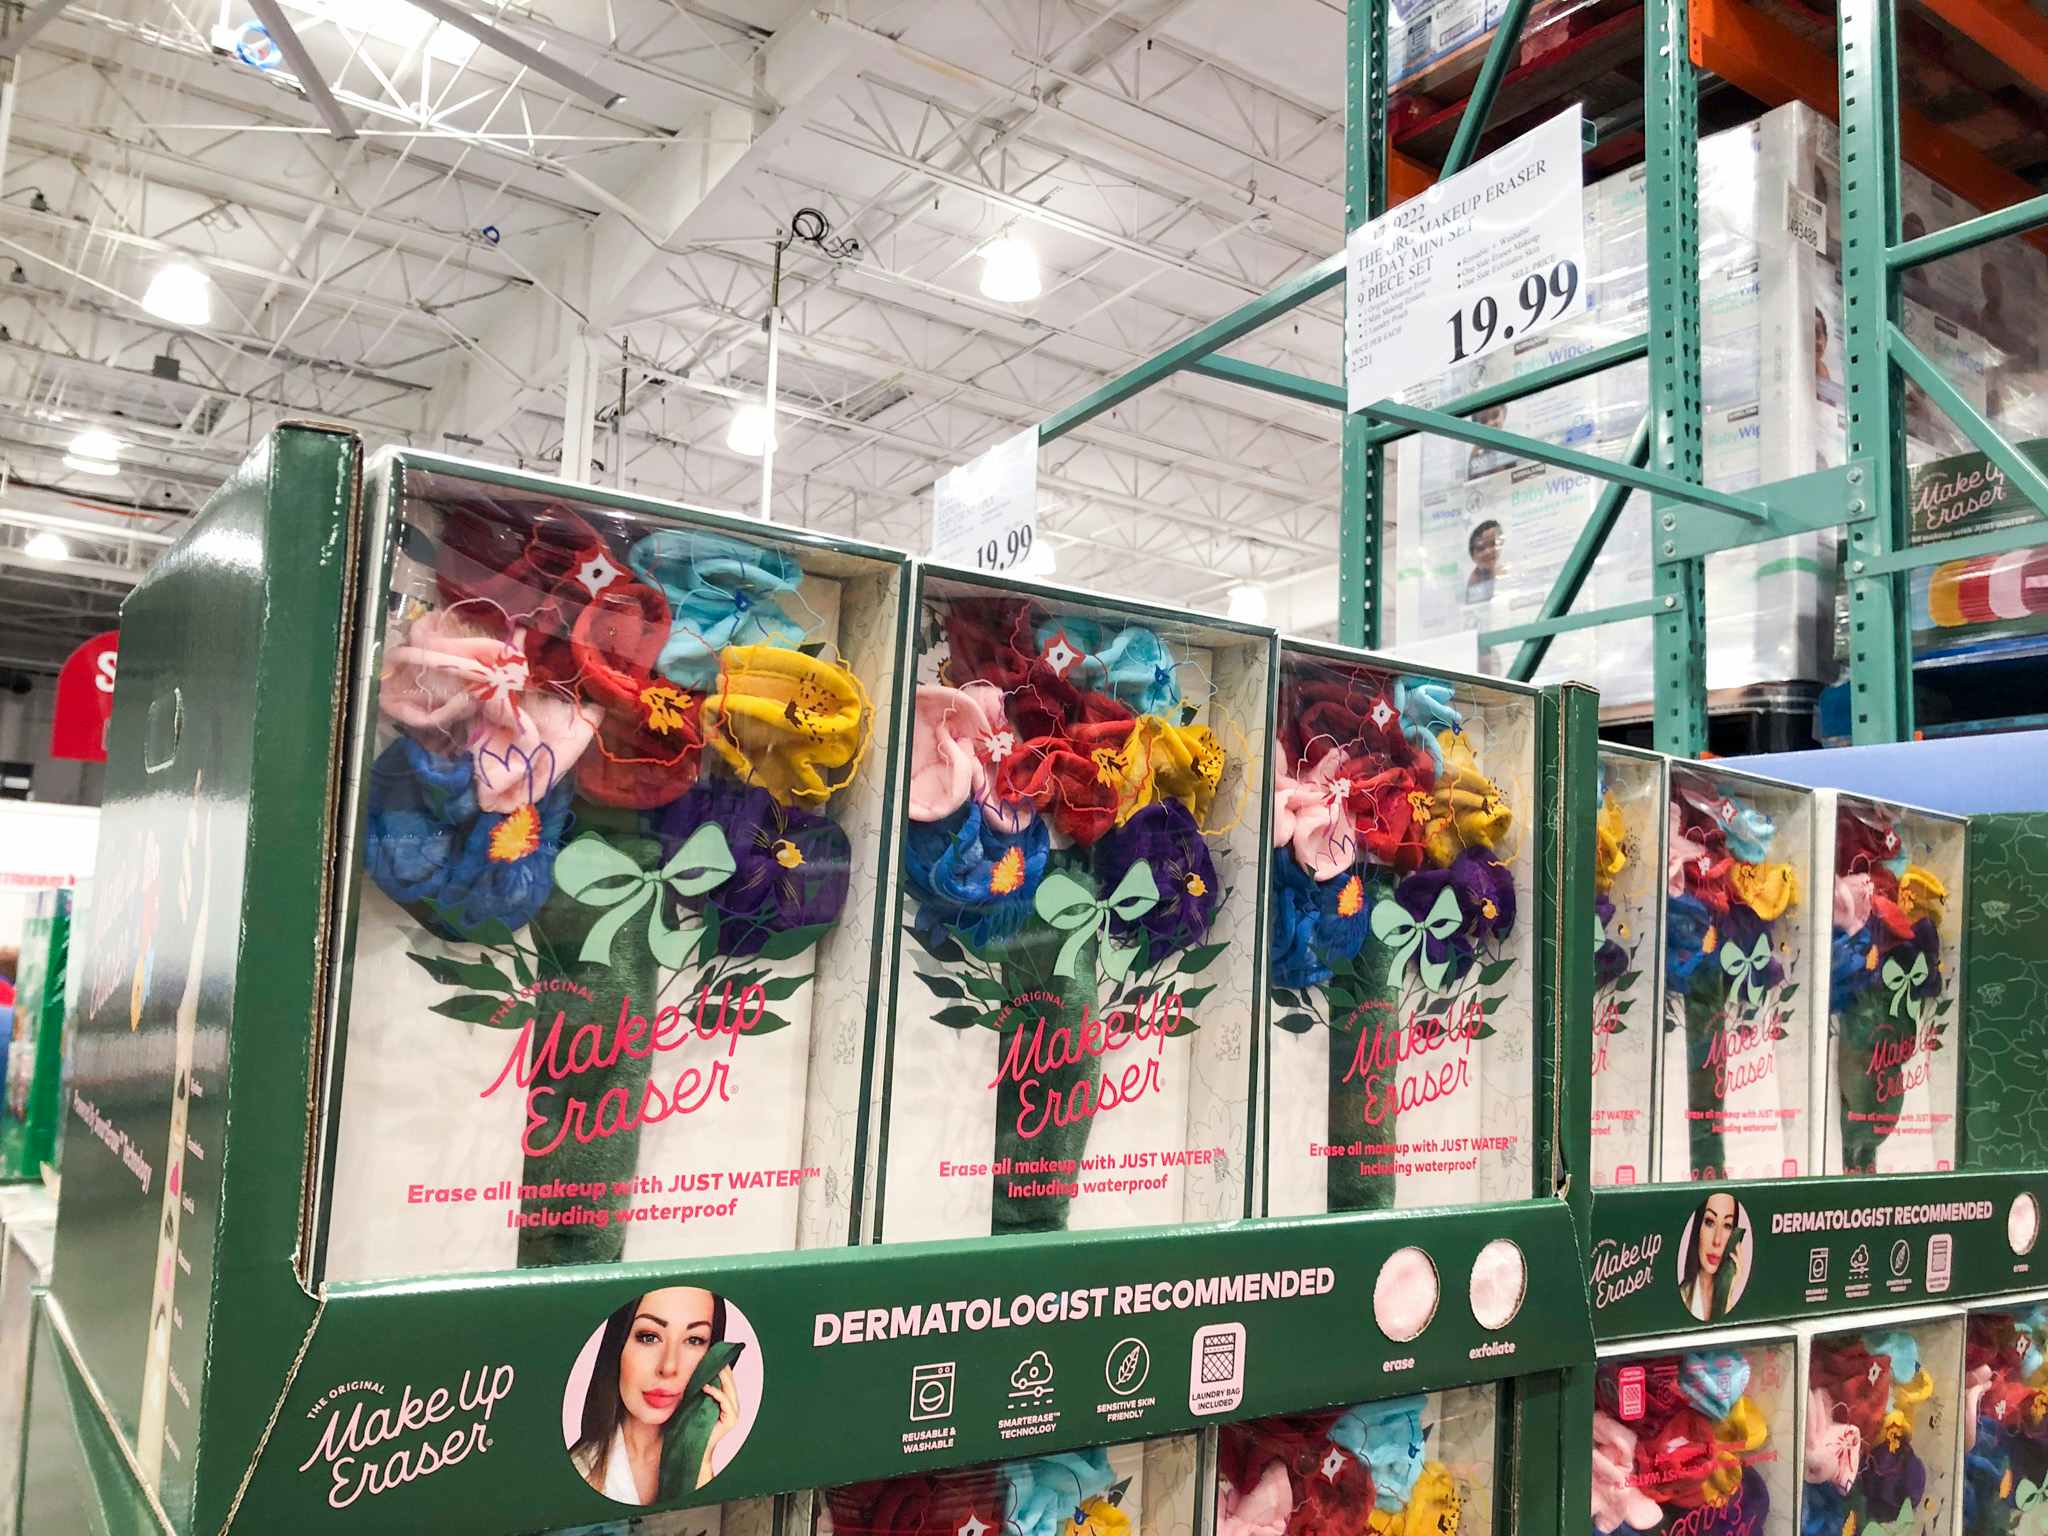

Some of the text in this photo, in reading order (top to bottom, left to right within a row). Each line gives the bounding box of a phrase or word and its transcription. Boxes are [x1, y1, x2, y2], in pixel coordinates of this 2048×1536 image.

[1357, 248, 1384, 272] THE
[1419, 194, 1481, 236] MAKEUP
[1486, 160, 1546, 203] ERASER
[1378, 255, 1406, 279] DAY
[1412, 236, 1444, 259] MINI
[1357, 255, 1434, 306] 9 PIECE SET
[1447, 259, 1579, 364] 19.99
[1926, 485, 2004, 530] Eraser
[977, 524, 1032, 570] 19.99
[489, 979, 593, 1024] THE ORIGINAL
[993, 990, 1066, 1029] THE ORIGINAL
[1714, 1051, 1775, 1099] Eraser
[1310, 1143, 1345, 1157] Erase
[1347, 1141, 1361, 1156] all
[1412, 1139, 1438, 1153] with
[1440, 1138, 1468, 1152] JUST
[939, 1161, 987, 1177] Erase
[992, 1158, 1011, 1175] all
[1015, 1157, 1077, 1177] makeup
[1080, 1154, 1116, 1170] with
[1119, 1152, 1157, 1169] JUST
[1360, 1157, 1478, 1176] Including waterproof
[408, 1184, 477, 1204] Erase
[483, 1181, 512, 1201] all
[517, 1178, 607, 1202] makeup
[612, 1175, 663, 1197] with
[668, 1173, 723, 1193] JUST
[1083, 1174, 1169, 1194] waterproof
[507, 1198, 738, 1229] Including waterproof
[1771, 1200, 1993, 1234] DERMATOLOGIST RECOMMENDED
[1596, 1266, 1652, 1309] Eraser
[813, 1266, 1336, 1347] DERMATOLOGIST RECOMMENDED
[1382, 1357, 1415, 1372] erase
[1469, 1341, 1516, 1360] exfoliate
[306, 1380, 385, 1420] THE ORIGINAL
[1096, 1397, 1156, 1414] SENSITIVE SKIN
[1192, 1387, 1241, 1401] LAUNDRY BAG
[1198, 1398, 1234, 1411] INCLUDED
[1000, 1423, 1057, 1440] TECHNOLOGY
[1107, 1409, 1144, 1423] FRIENDLY
[902, 1428, 949, 1443] REUSABLE
[903, 1439, 954, 1454] WASHABLE
